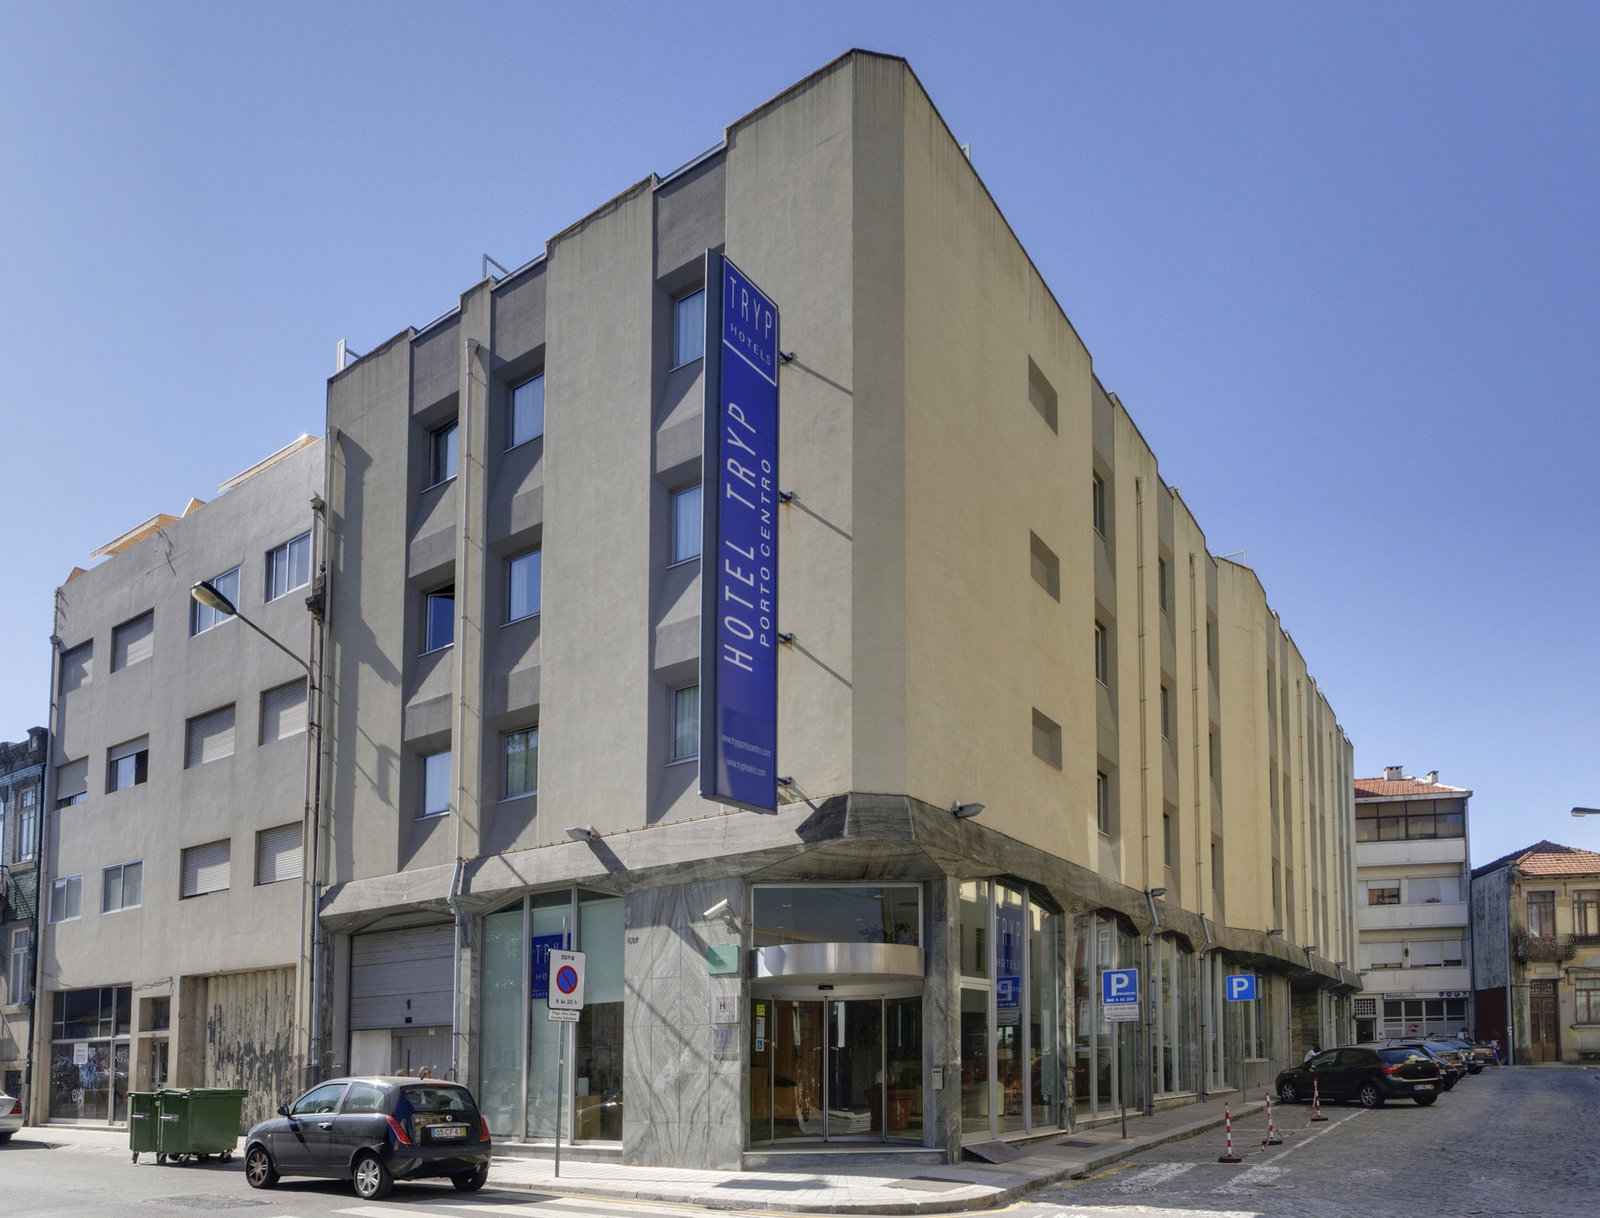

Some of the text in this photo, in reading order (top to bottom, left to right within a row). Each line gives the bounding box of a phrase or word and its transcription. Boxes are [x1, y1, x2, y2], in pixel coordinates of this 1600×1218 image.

[730, 276, 772, 339] TRYP
[730, 322, 771, 366] HOTELS
[724, 402, 756, 672] HOTEL TRYP
[760, 459, 771, 647] PORTO CENTRO
[1111, 973, 1129, 996] P
[1232, 978, 1249, 998] P
